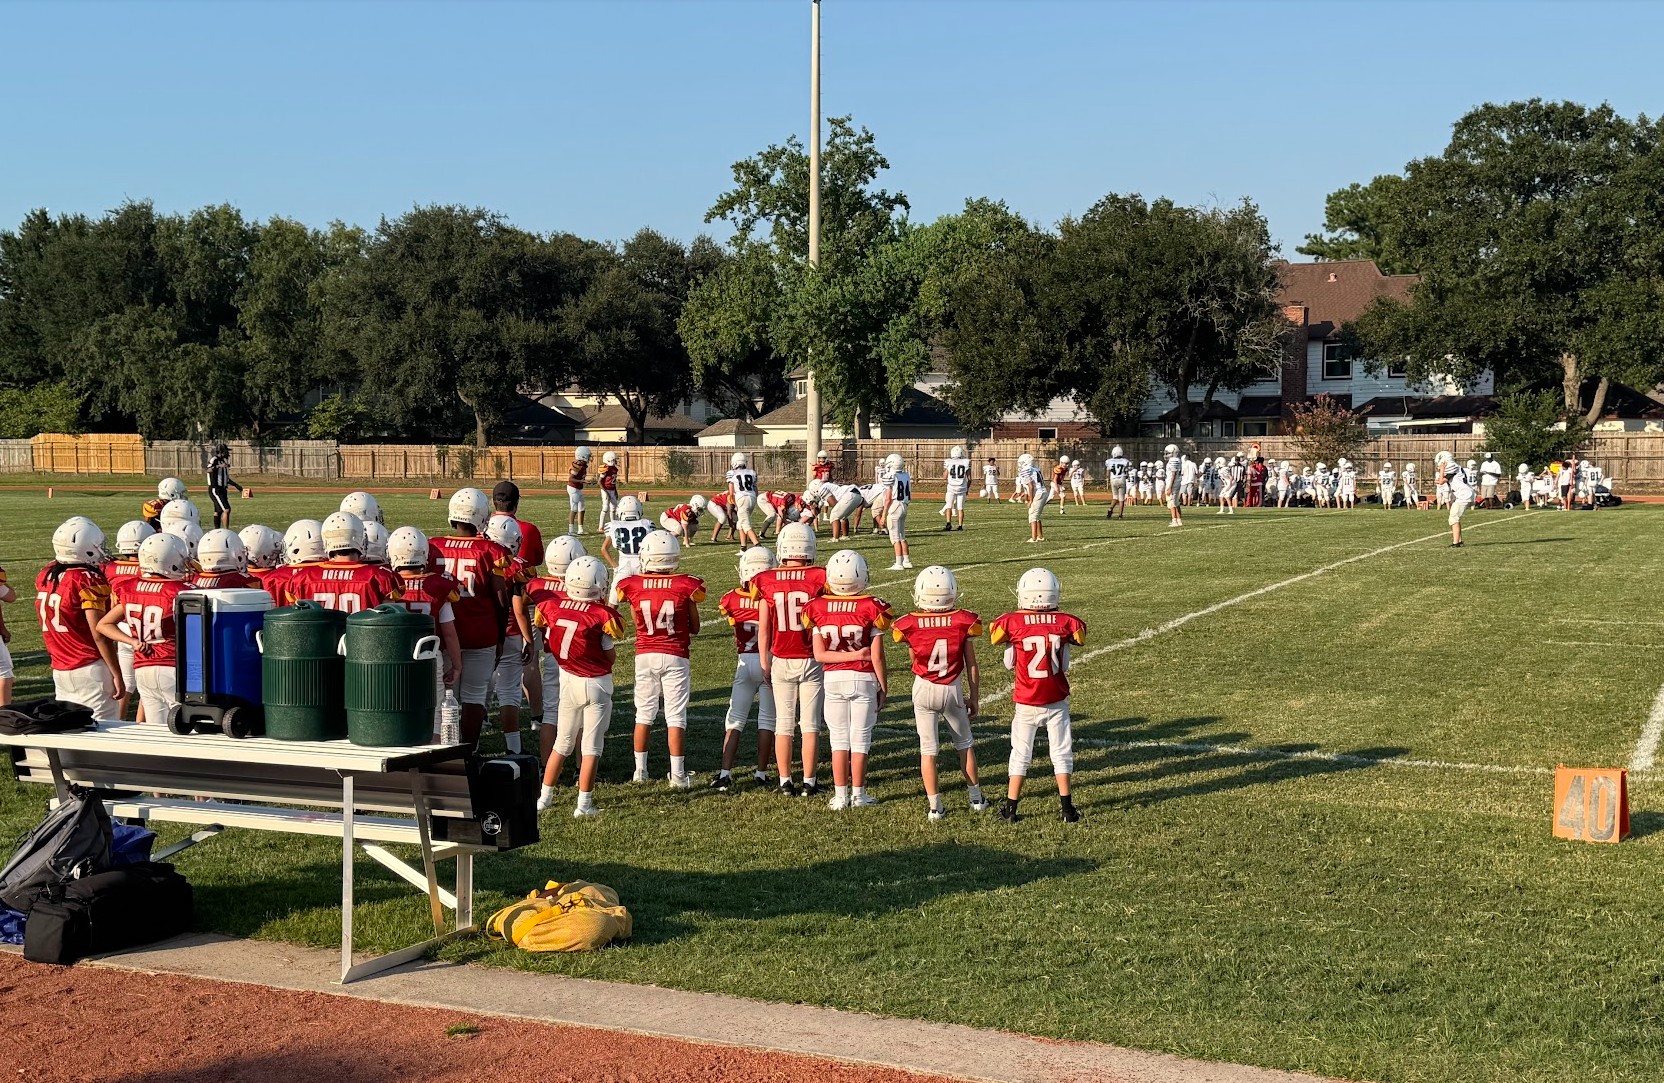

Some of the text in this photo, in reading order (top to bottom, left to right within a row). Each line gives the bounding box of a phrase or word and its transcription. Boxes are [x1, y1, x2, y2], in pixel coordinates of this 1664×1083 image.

[736, 474, 753, 492] 18
[949, 464, 966, 479] 40
[436, 558, 477, 598] 75
[37, 591, 69, 633] 72
[126, 603, 163, 644] 58
[640, 600, 676, 636] 14
[773, 591, 809, 632] 16
[555, 618, 579, 660] 7
[927, 638, 949, 678] 4
[1022, 633, 1061, 679] 21
[1558, 774, 1617, 841] 40
